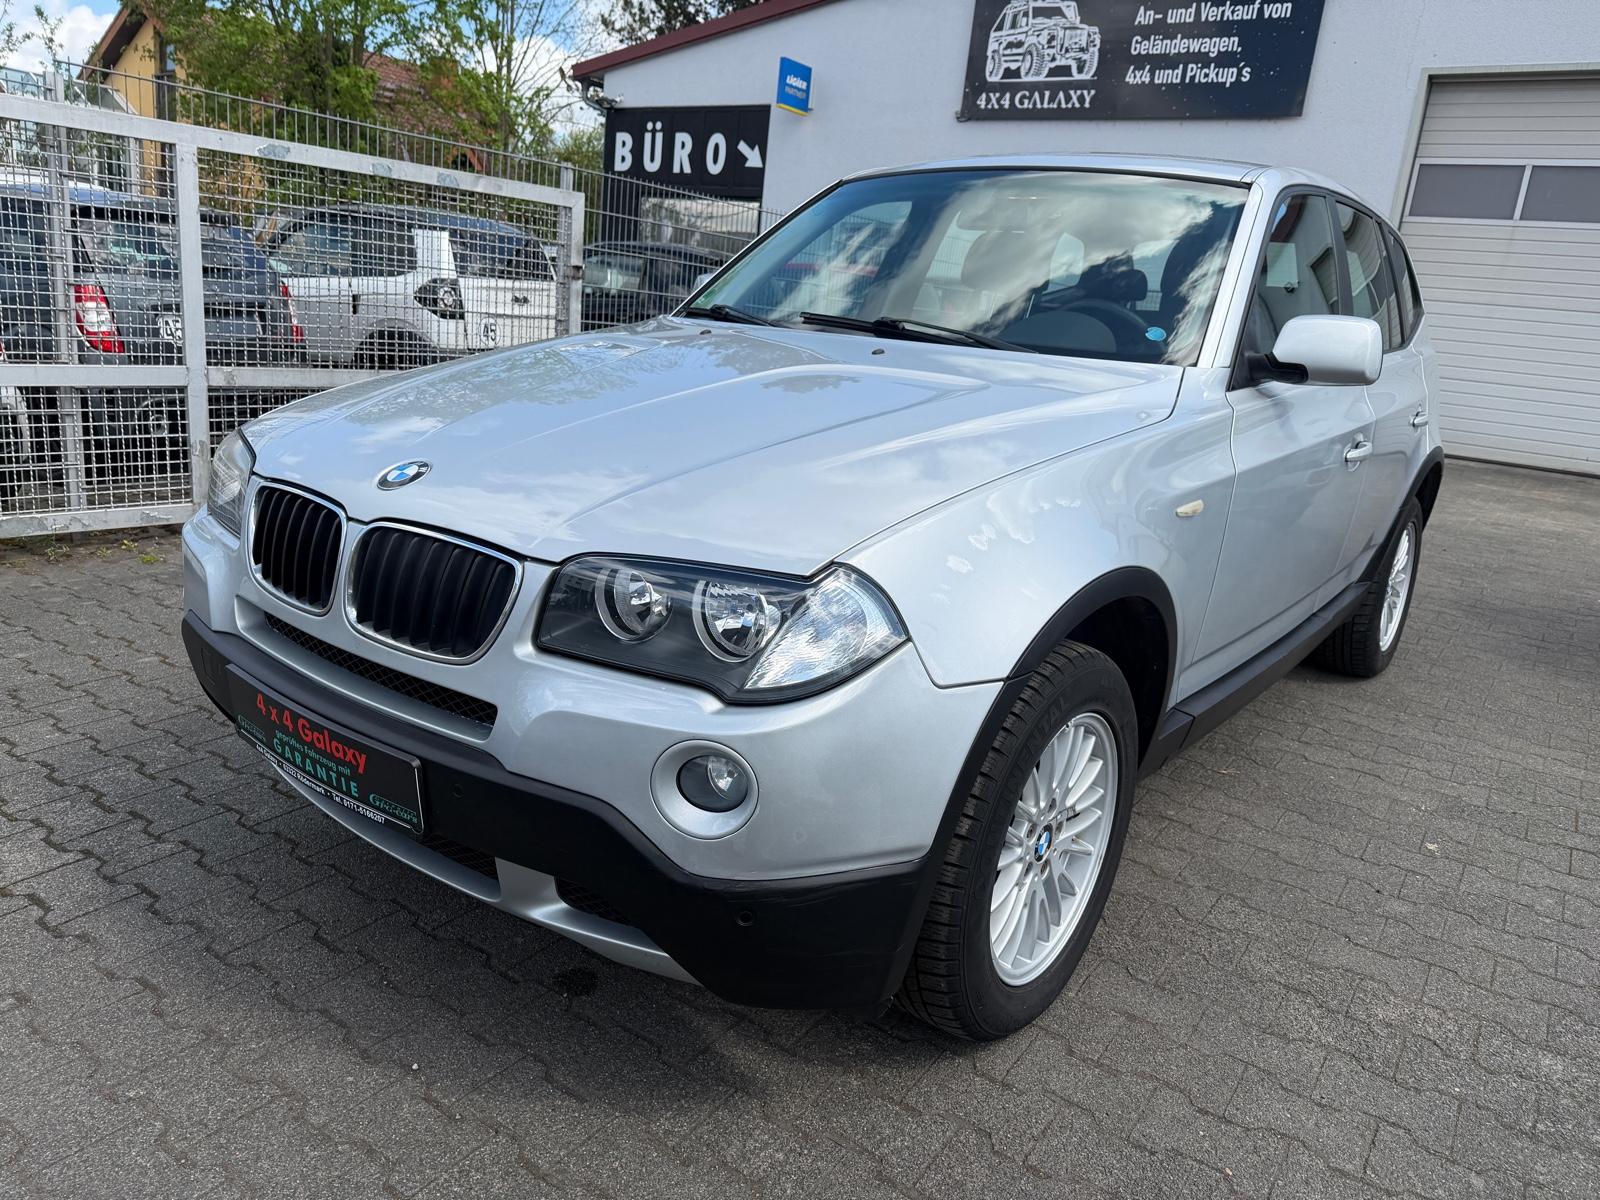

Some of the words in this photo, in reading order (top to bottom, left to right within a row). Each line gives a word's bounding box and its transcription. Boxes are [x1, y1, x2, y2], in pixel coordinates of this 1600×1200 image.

[1134, 5, 1163, 26] An-
[1166, 2, 1197, 24] und
[1200, 0, 1261, 22] Verkauf
[1263, 2, 1293, 19] von
[1130, 33, 1242, 57] Geländewagen,
[1125, 64, 1151, 85] 4x4
[1154, 63, 1184, 84] und
[976, 91, 1011, 110] 4X4
[1014, 89, 1097, 109] GALAXY
[613, 121, 727, 175] BÜRO
[256, 692, 266, 716] 4
[269, 706, 279, 725] x
[283, 709, 294, 733] 4
[297, 717, 367, 775] Galaxy
[273, 737, 359, 798] GARANTIE
